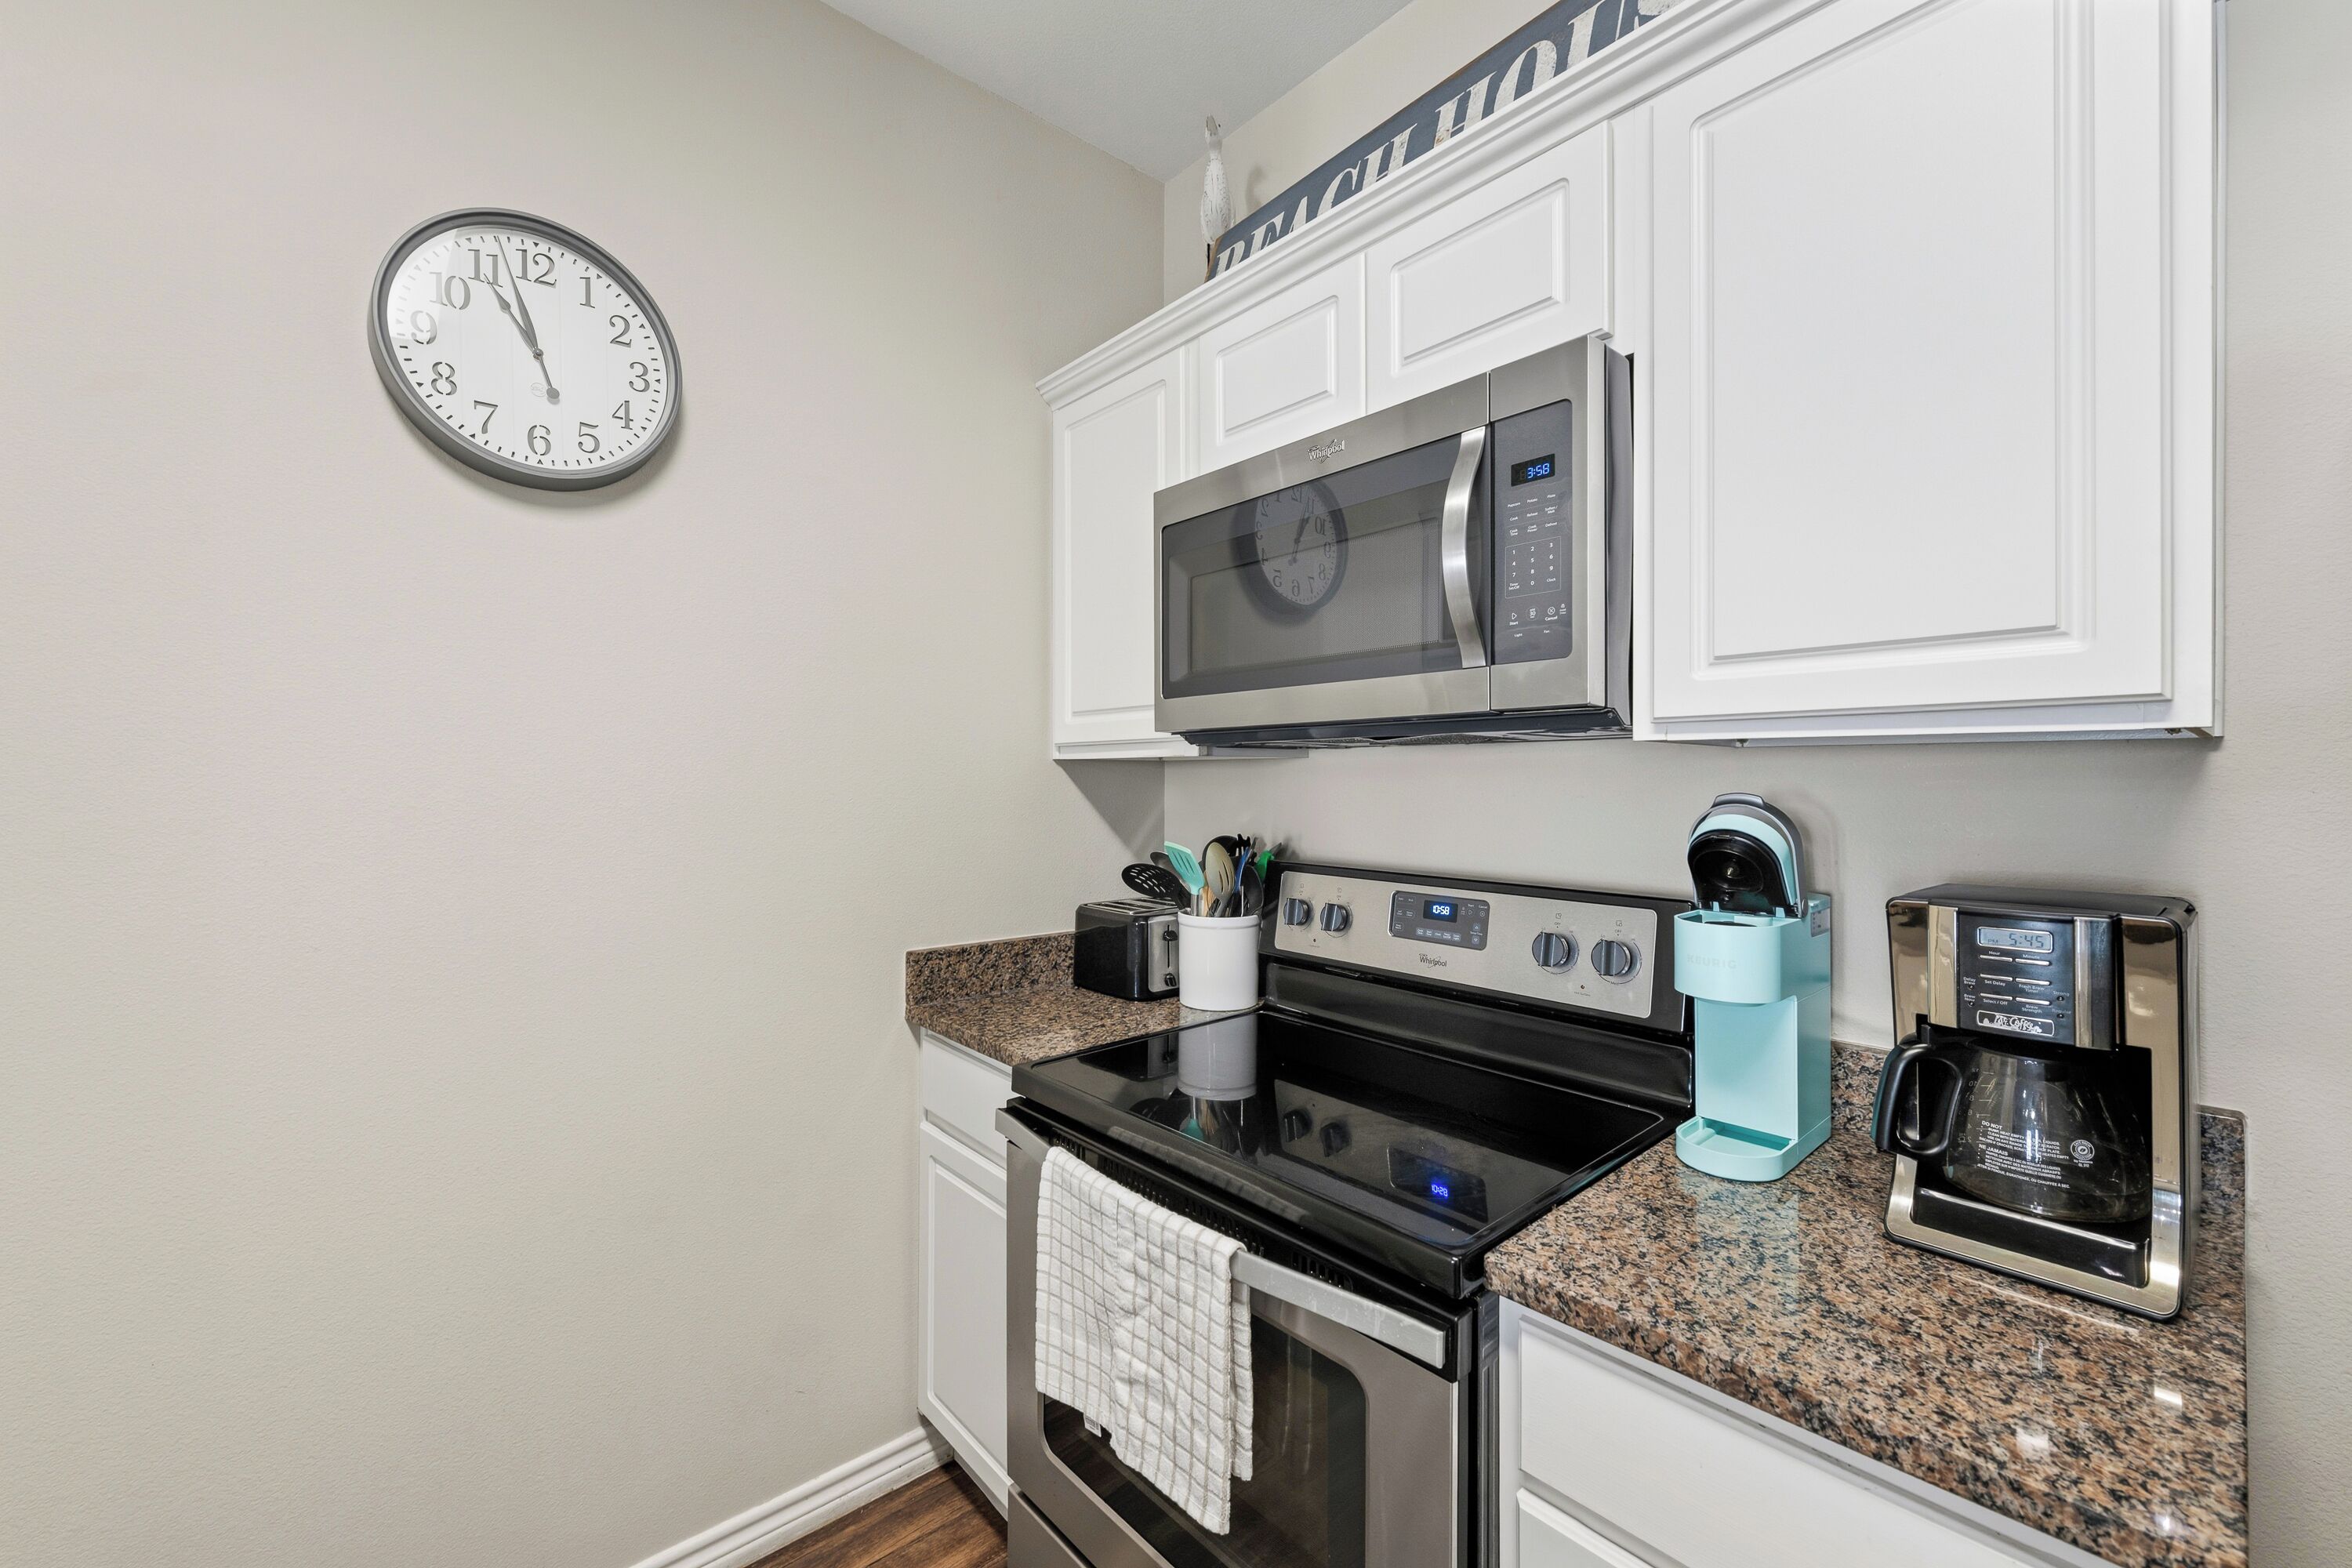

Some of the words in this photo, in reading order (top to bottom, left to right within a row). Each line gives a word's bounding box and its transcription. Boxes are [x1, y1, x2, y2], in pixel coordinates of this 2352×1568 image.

[468, 249, 503, 288] 11
[516, 249, 557, 289] 12
[429, 272, 470, 310] 10
[579, 277, 596, 309] 1
[411, 310, 437, 345] 9
[609, 315, 632, 348] 2
[431, 362, 458, 396] 8
[629, 362, 650, 393] 3
[474, 401, 498, 434] 7
[612, 401, 633, 430] 4
[528, 425, 551, 456] 6
[578, 422, 600, 454] 5
[1308, 439, 1345, 463] Whirlpool
[1527, 463, 1549, 478] 3:58
[1433, 905, 1450, 916] 10:58
[2009, 933, 2044, 948] 5:45
[1419, 954, 1447, 968] Whirlpool
[1687, 954, 1737, 970] KEURIG
[2009, 1017, 2034, 1031] Coffee
[1987, 1146, 2009, 1156] JAMAIS
